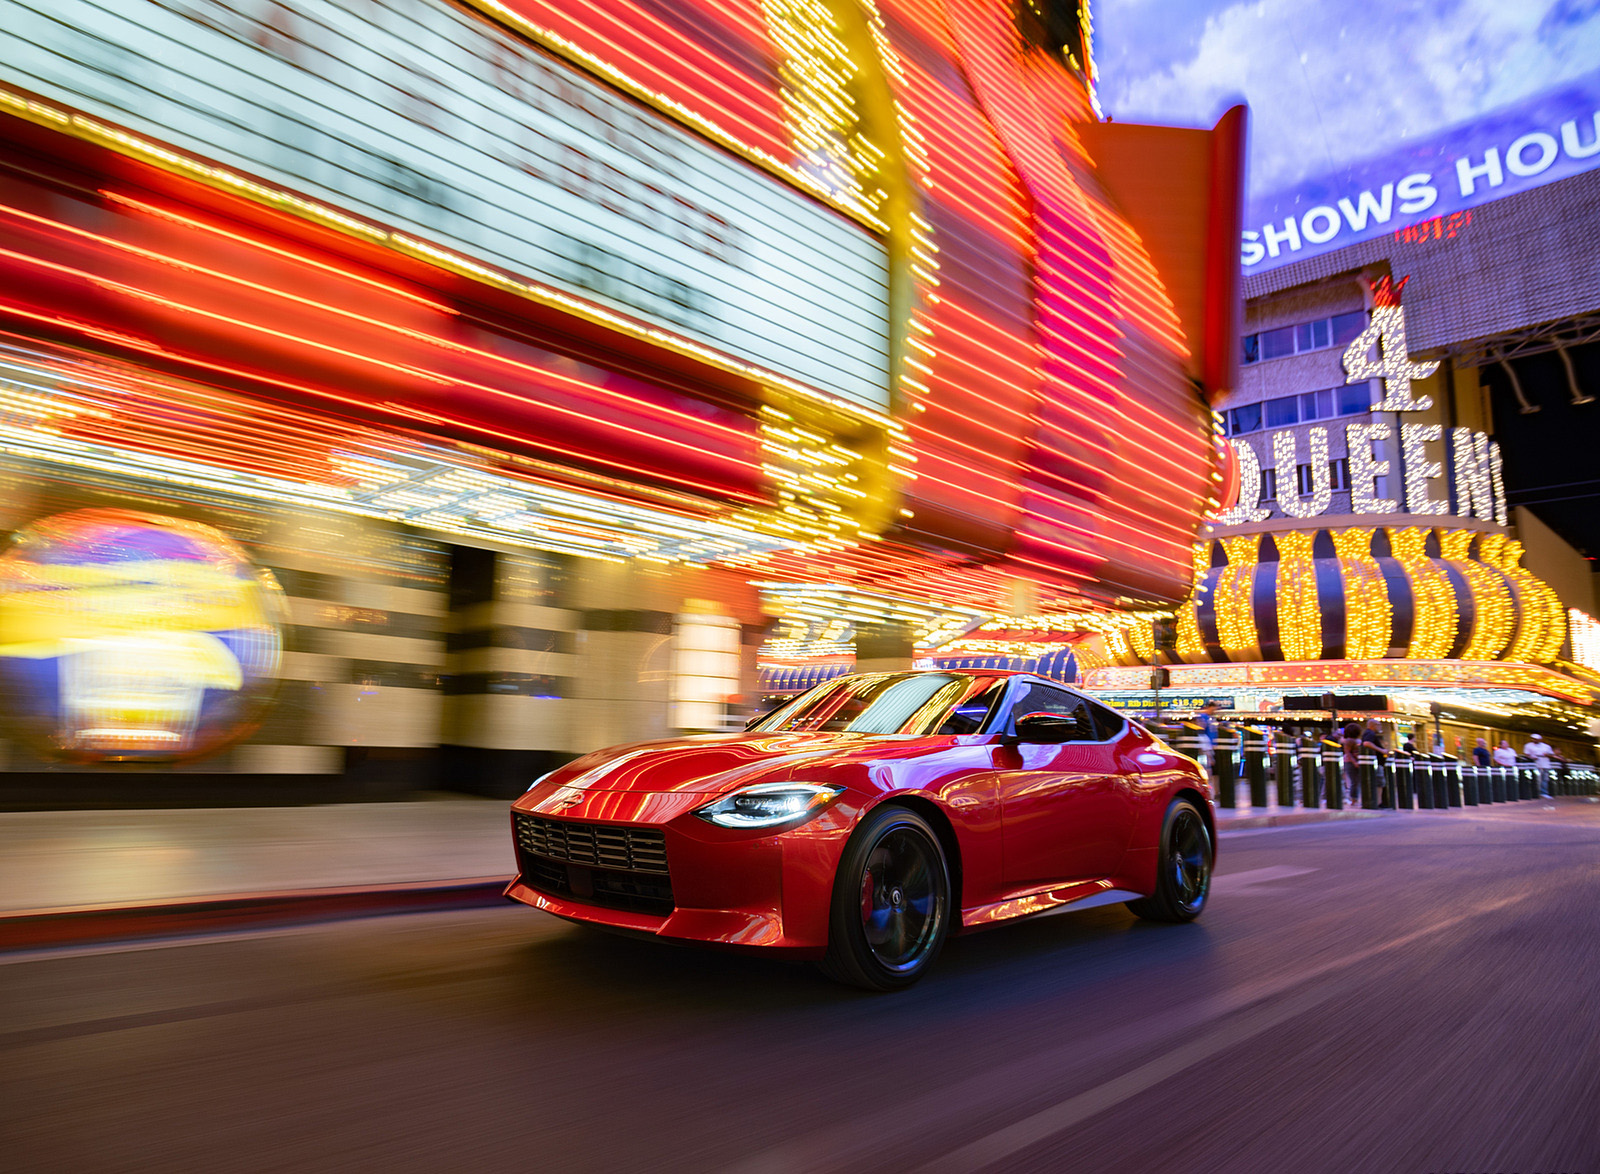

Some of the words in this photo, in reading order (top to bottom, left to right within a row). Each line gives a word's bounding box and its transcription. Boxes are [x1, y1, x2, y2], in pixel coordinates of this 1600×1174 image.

[1241, 173, 1438, 265] SHOWS
[1456, 111, 1600, 197] HOU
[1343, 305, 1440, 412] 4
[1127, 699, 1141, 707] Rib
[1172, 698, 1205, 707] $18.99
